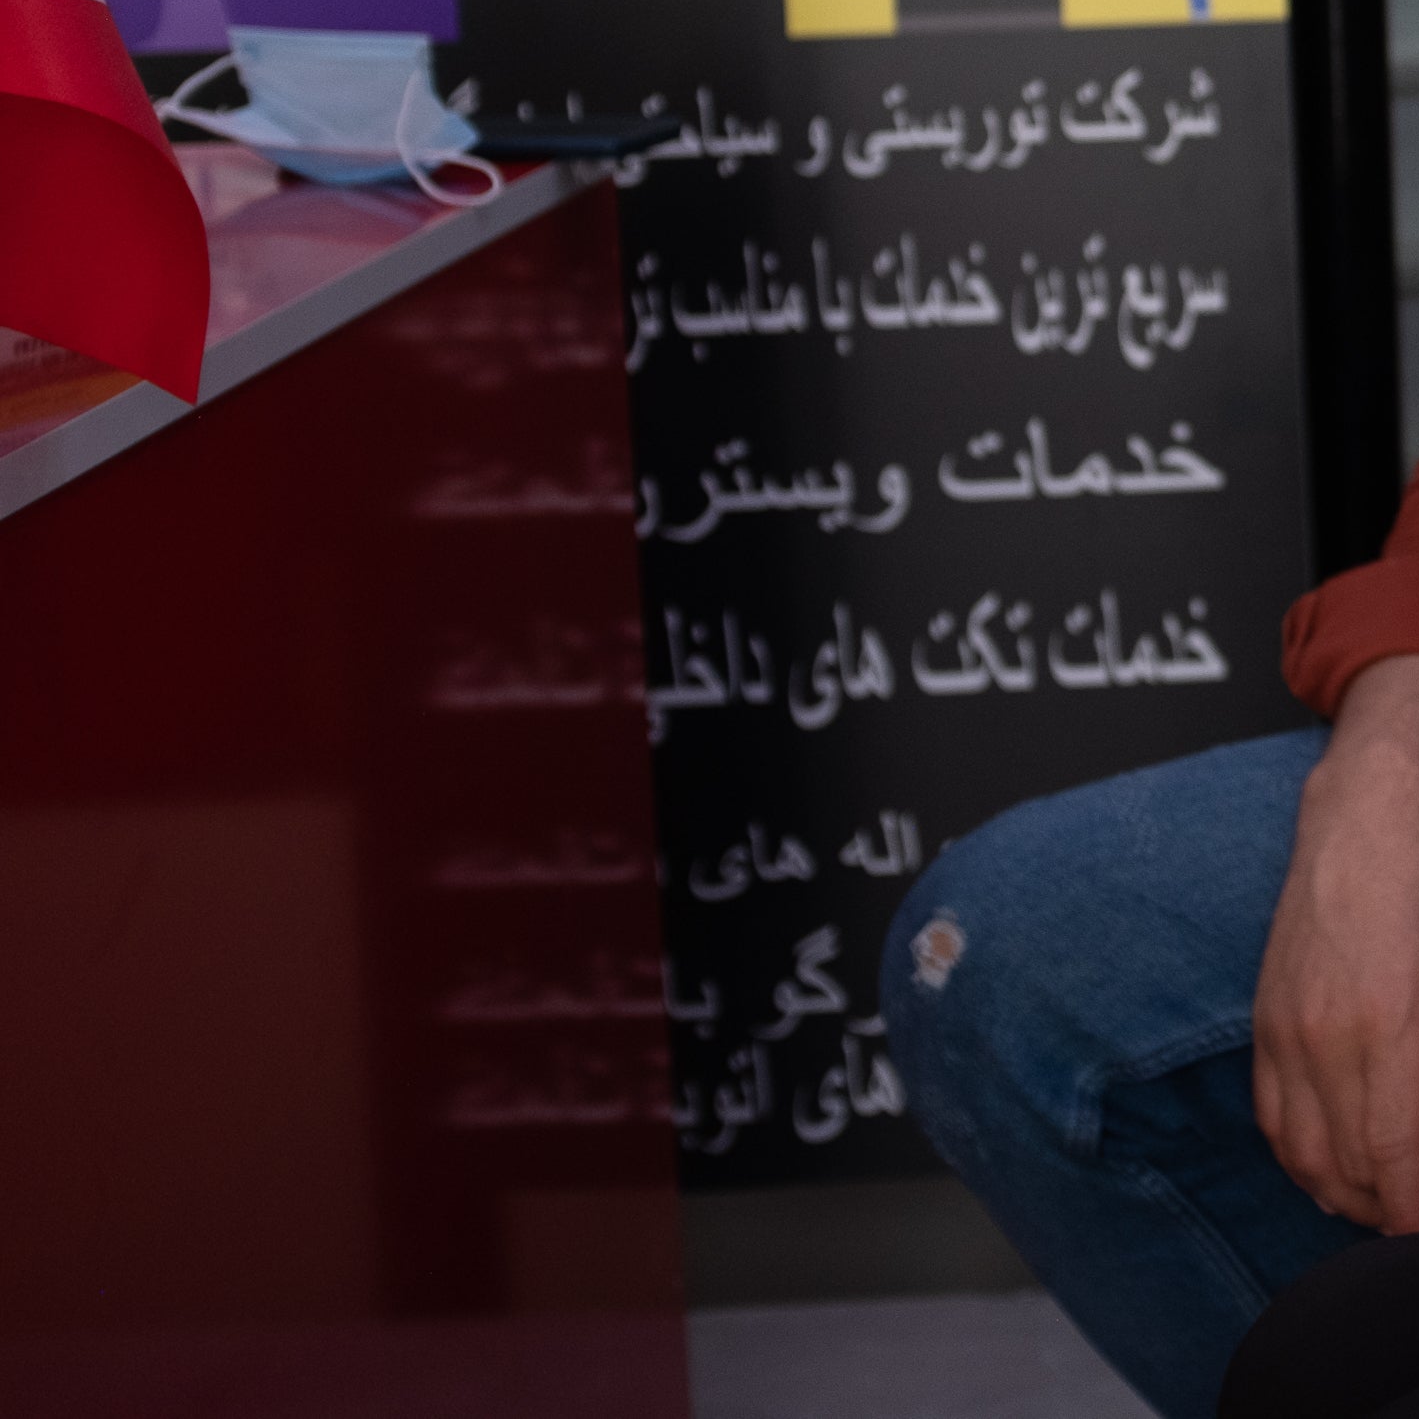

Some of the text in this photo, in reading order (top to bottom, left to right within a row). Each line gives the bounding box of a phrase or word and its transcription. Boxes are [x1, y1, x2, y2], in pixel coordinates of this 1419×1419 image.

[796, 114, 831, 176] و
[842, 79, 1047, 178] توریستی
[1060, 66, 1222, 163] شرکت
[670, 237, 809, 363] مناسب
[812, 235, 854, 357] با
[860, 235, 1002, 330] خدمات
[1010, 235, 1109, 355] ترین
[1117, 263, 1229, 371] سریع
[938, 416, 1228, 502] خدمات
[788, 599, 898, 730] های
[1048, 589, 1229, 690] خدمات
[688, 818, 819, 902] های
